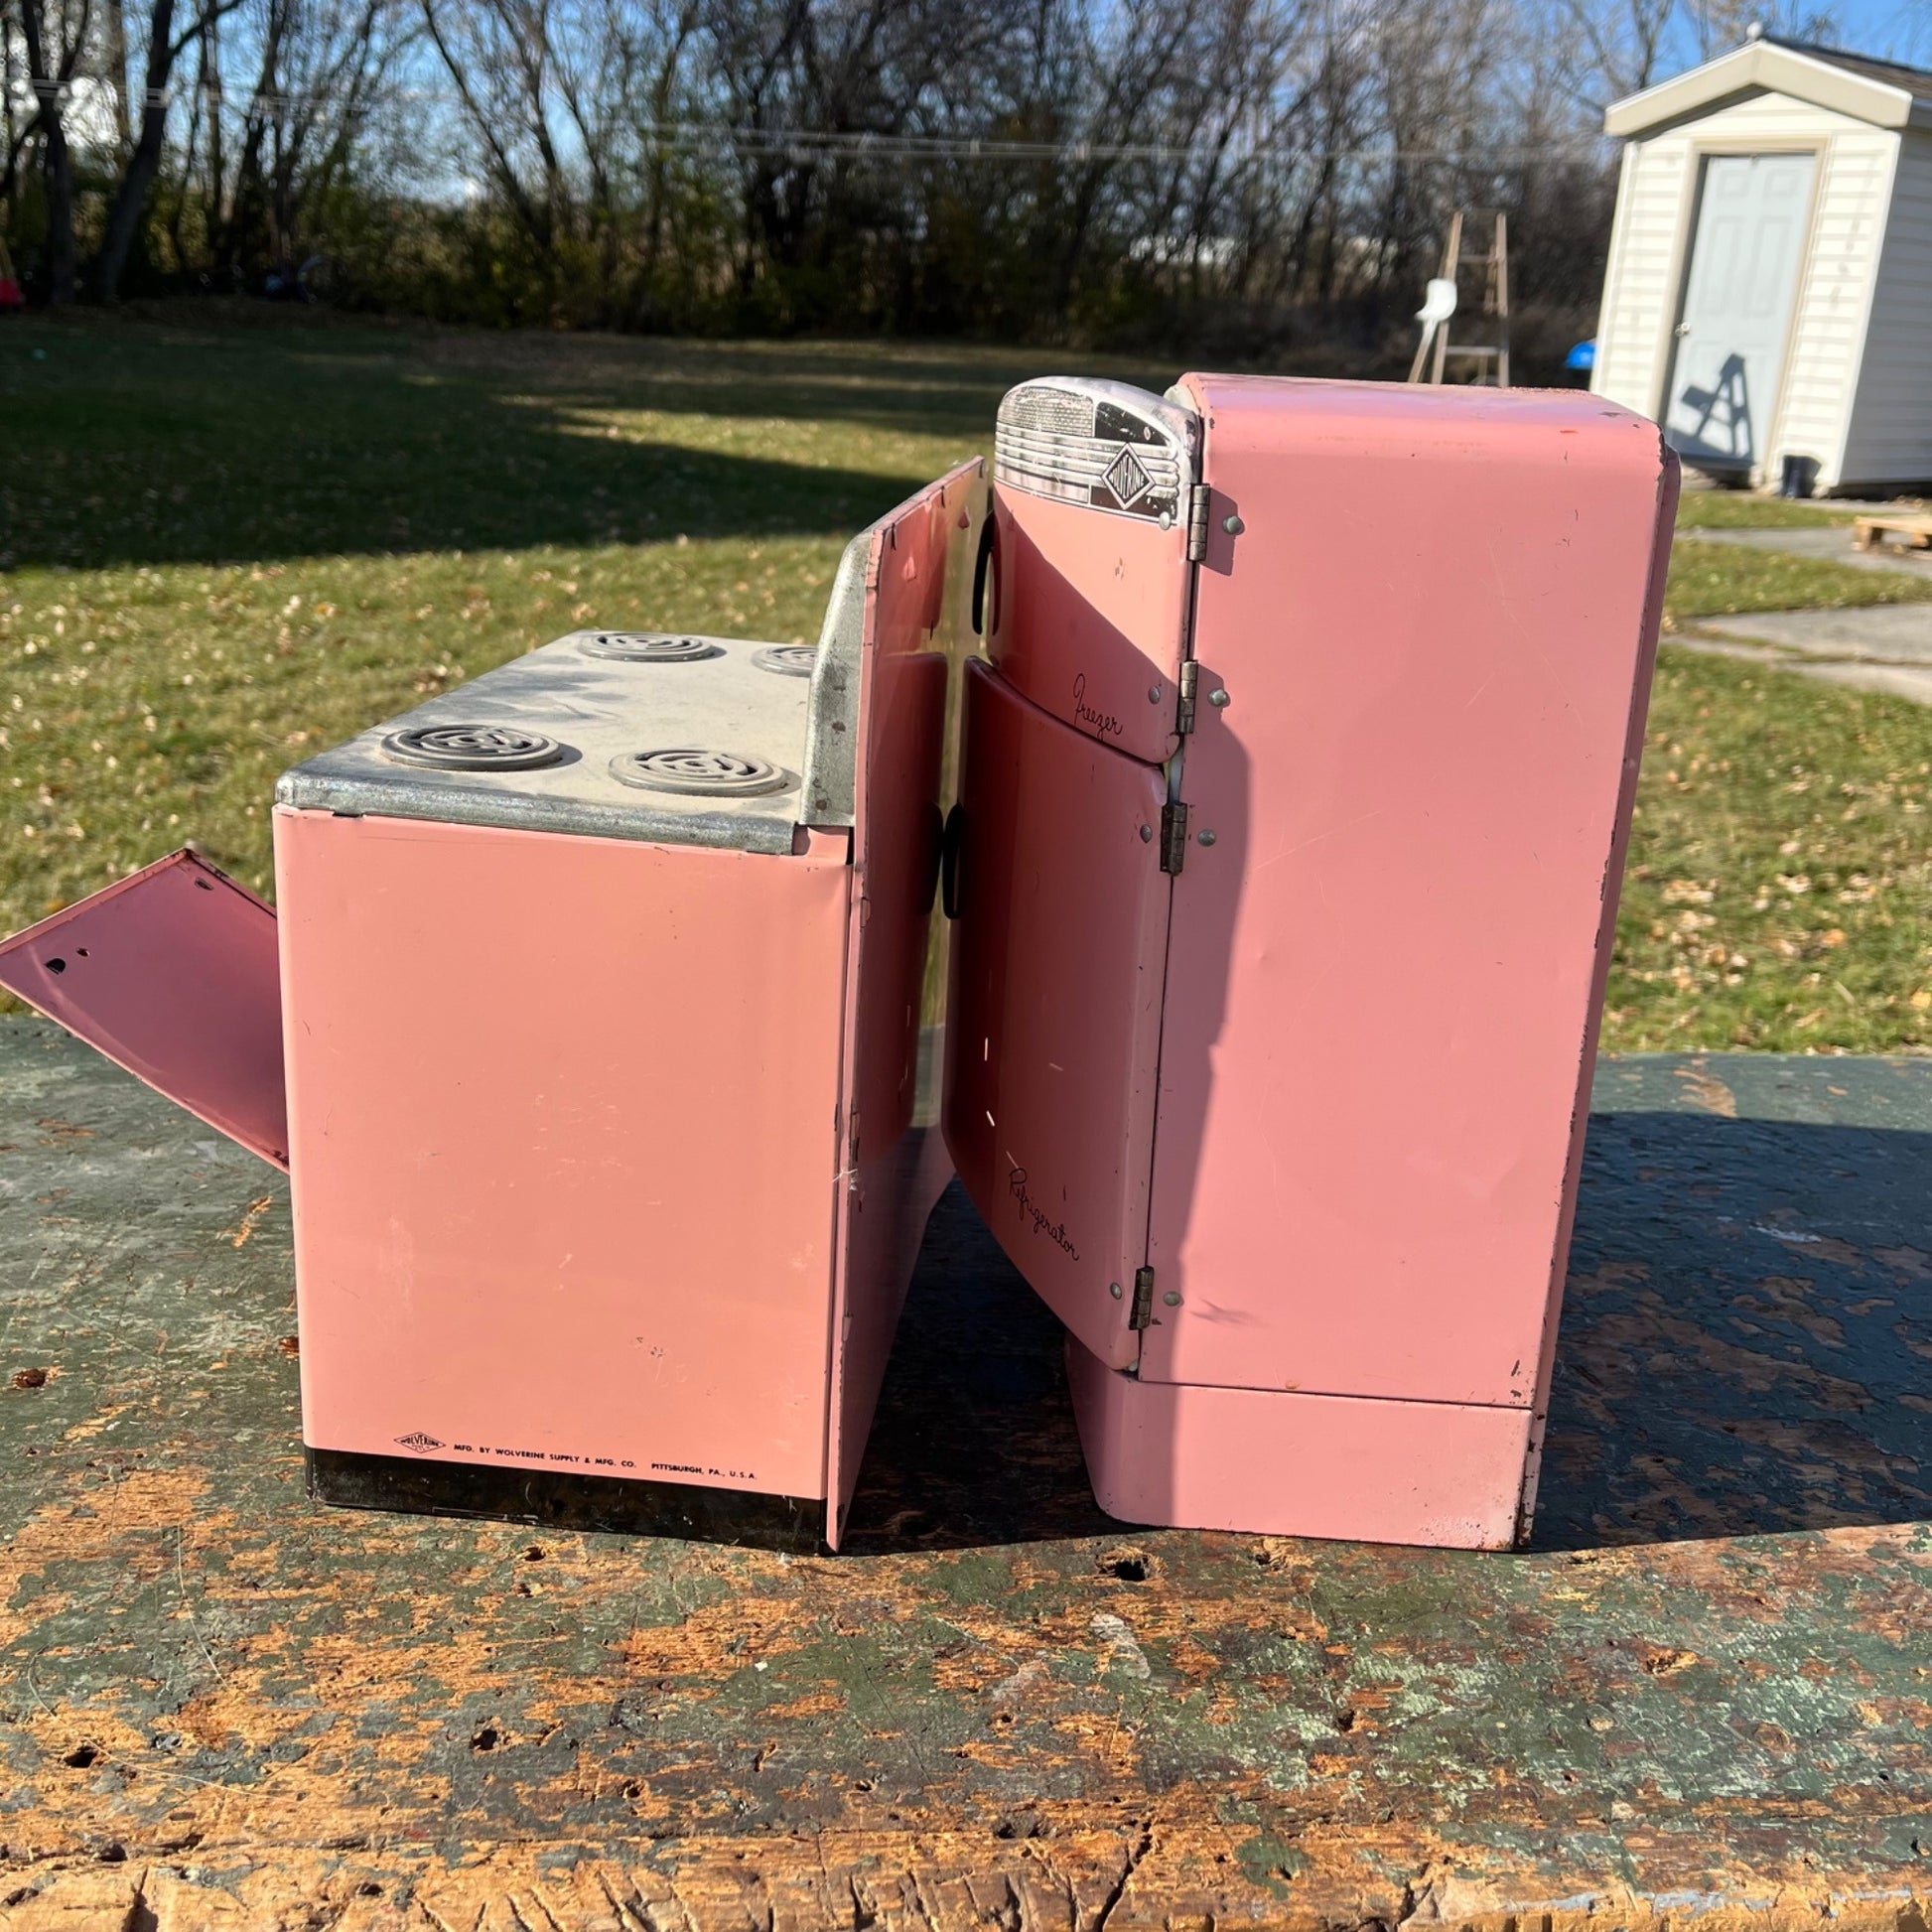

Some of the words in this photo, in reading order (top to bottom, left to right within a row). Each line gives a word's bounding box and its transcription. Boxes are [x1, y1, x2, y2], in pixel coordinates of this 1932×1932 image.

[1073, 673, 1123, 741] Freezer
[1009, 1168, 1079, 1261] Refrigerator
[454, 1444, 475, 1453] MFD.
[495, 1449, 545, 1459] WOLVERINE
[549, 1453, 579, 1462] SUPPLY
[651, 1463, 704, 1474] PITTSBURGH,
